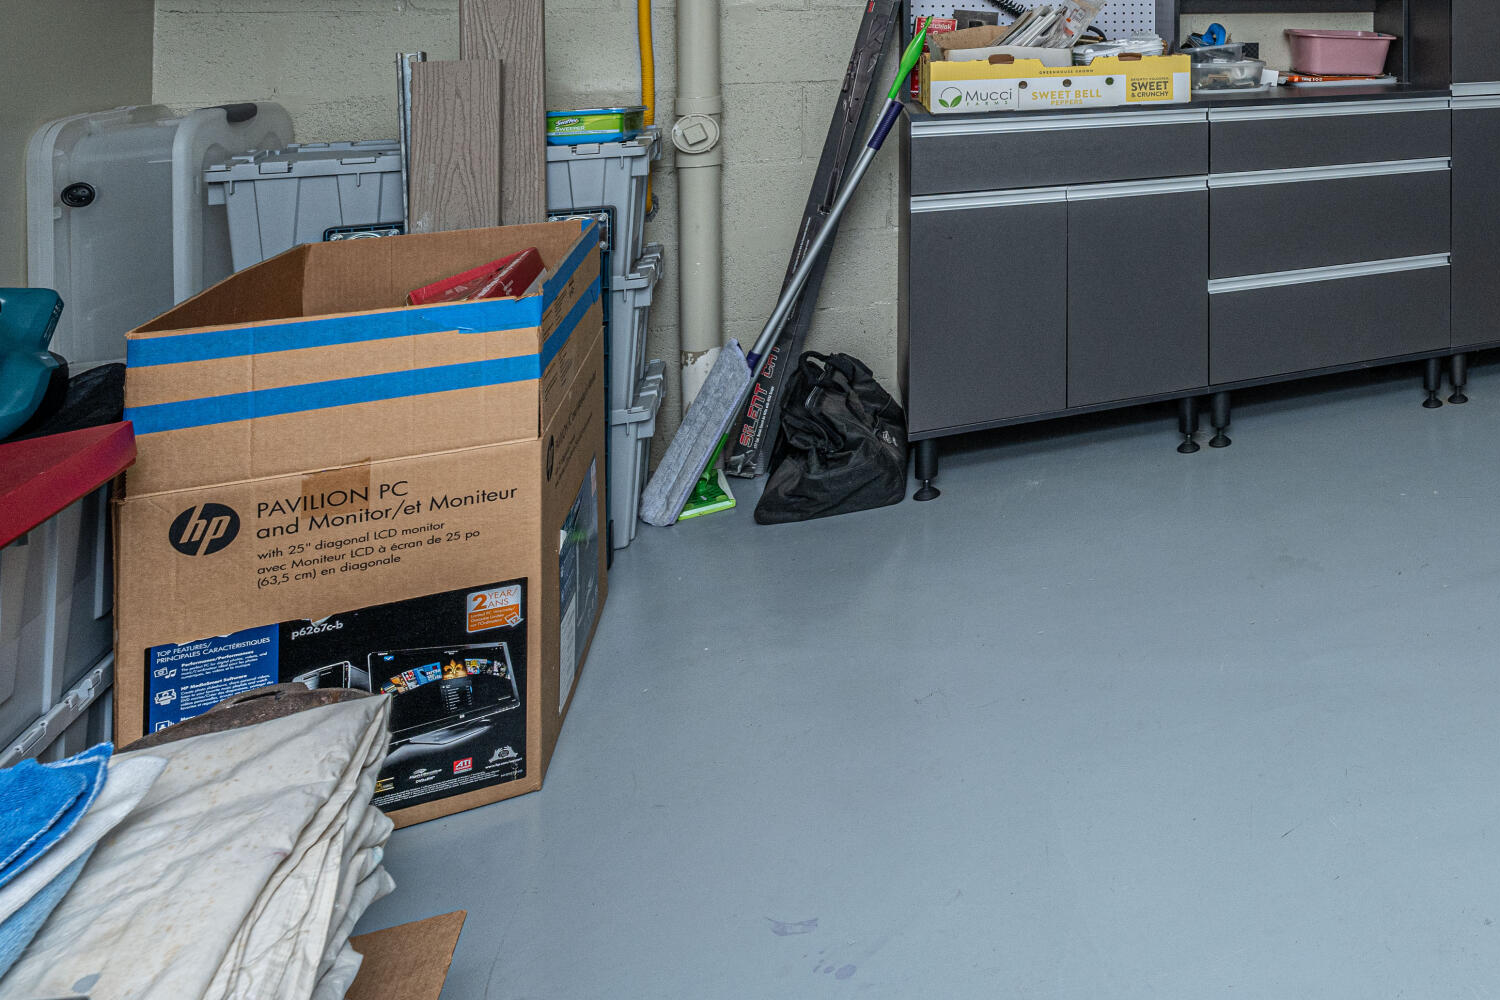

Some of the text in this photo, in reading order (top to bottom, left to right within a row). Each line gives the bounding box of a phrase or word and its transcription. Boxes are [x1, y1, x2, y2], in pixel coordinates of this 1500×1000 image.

[965, 88, 1012, 101] Mucci
[1032, 89, 1101, 100] SWEET BELL
[1131, 81, 1169, 91] SWEET
[257, 481, 408, 518] PAVILION PC
[256, 488, 518, 539] and Monitor/et Moniteur
[172, 503, 237, 556] hp
[257, 522, 445, 560] with 25" diagonal LCD monitor
[257, 530, 480, 575] avec Moniteur LCD à écran de 25 po
[257, 554, 401, 589] (63,5 cm) en diagonale
[472, 587, 519, 611] 2 YEAR/
[487, 598, 509, 608] ANS
[157, 641, 212, 658] TOP FEATURES/
[157, 637, 271, 664] PRINCIPALES CARACTÉRISTIQUES
[456, 759, 471, 768] ATI
